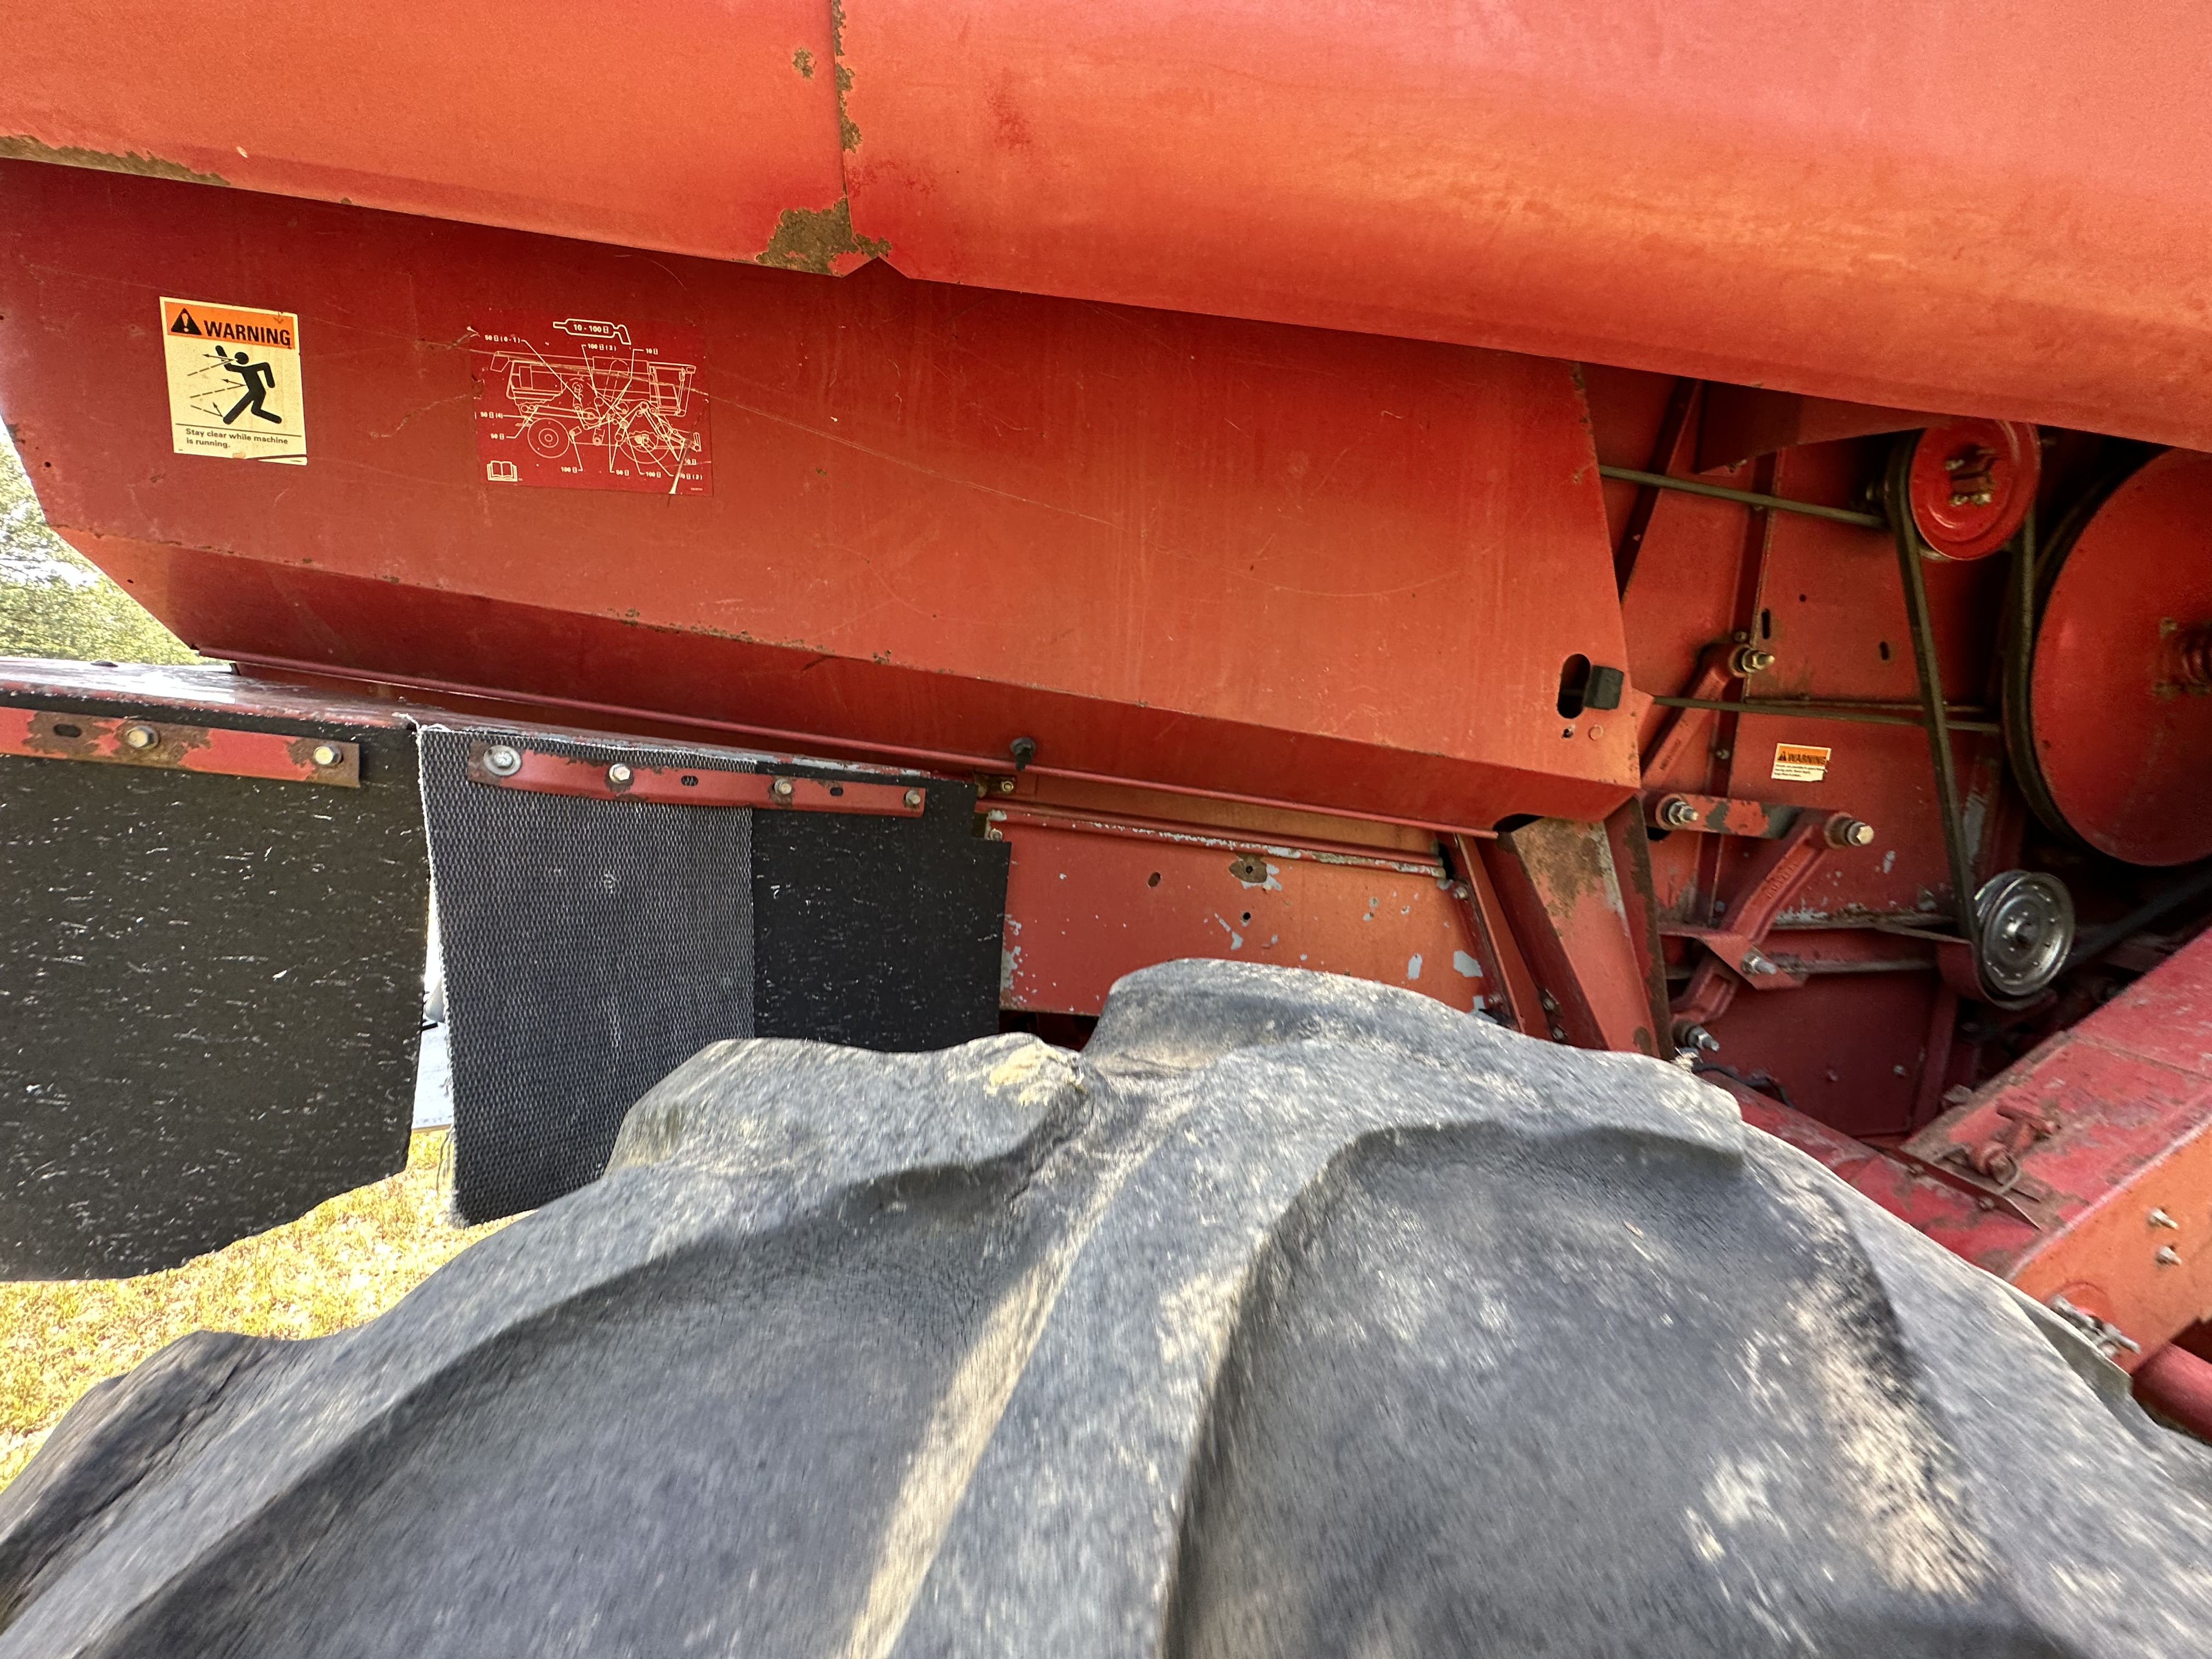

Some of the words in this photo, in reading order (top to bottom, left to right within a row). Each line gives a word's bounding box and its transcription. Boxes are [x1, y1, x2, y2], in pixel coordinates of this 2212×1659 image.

[204, 320, 291, 346] WARNING
[185, 428, 205, 437] Stay
[207, 430, 227, 438] clear
[229, 433, 251, 441] while
[253, 435, 288, 444] machine
[195, 439, 230, 449] running.
